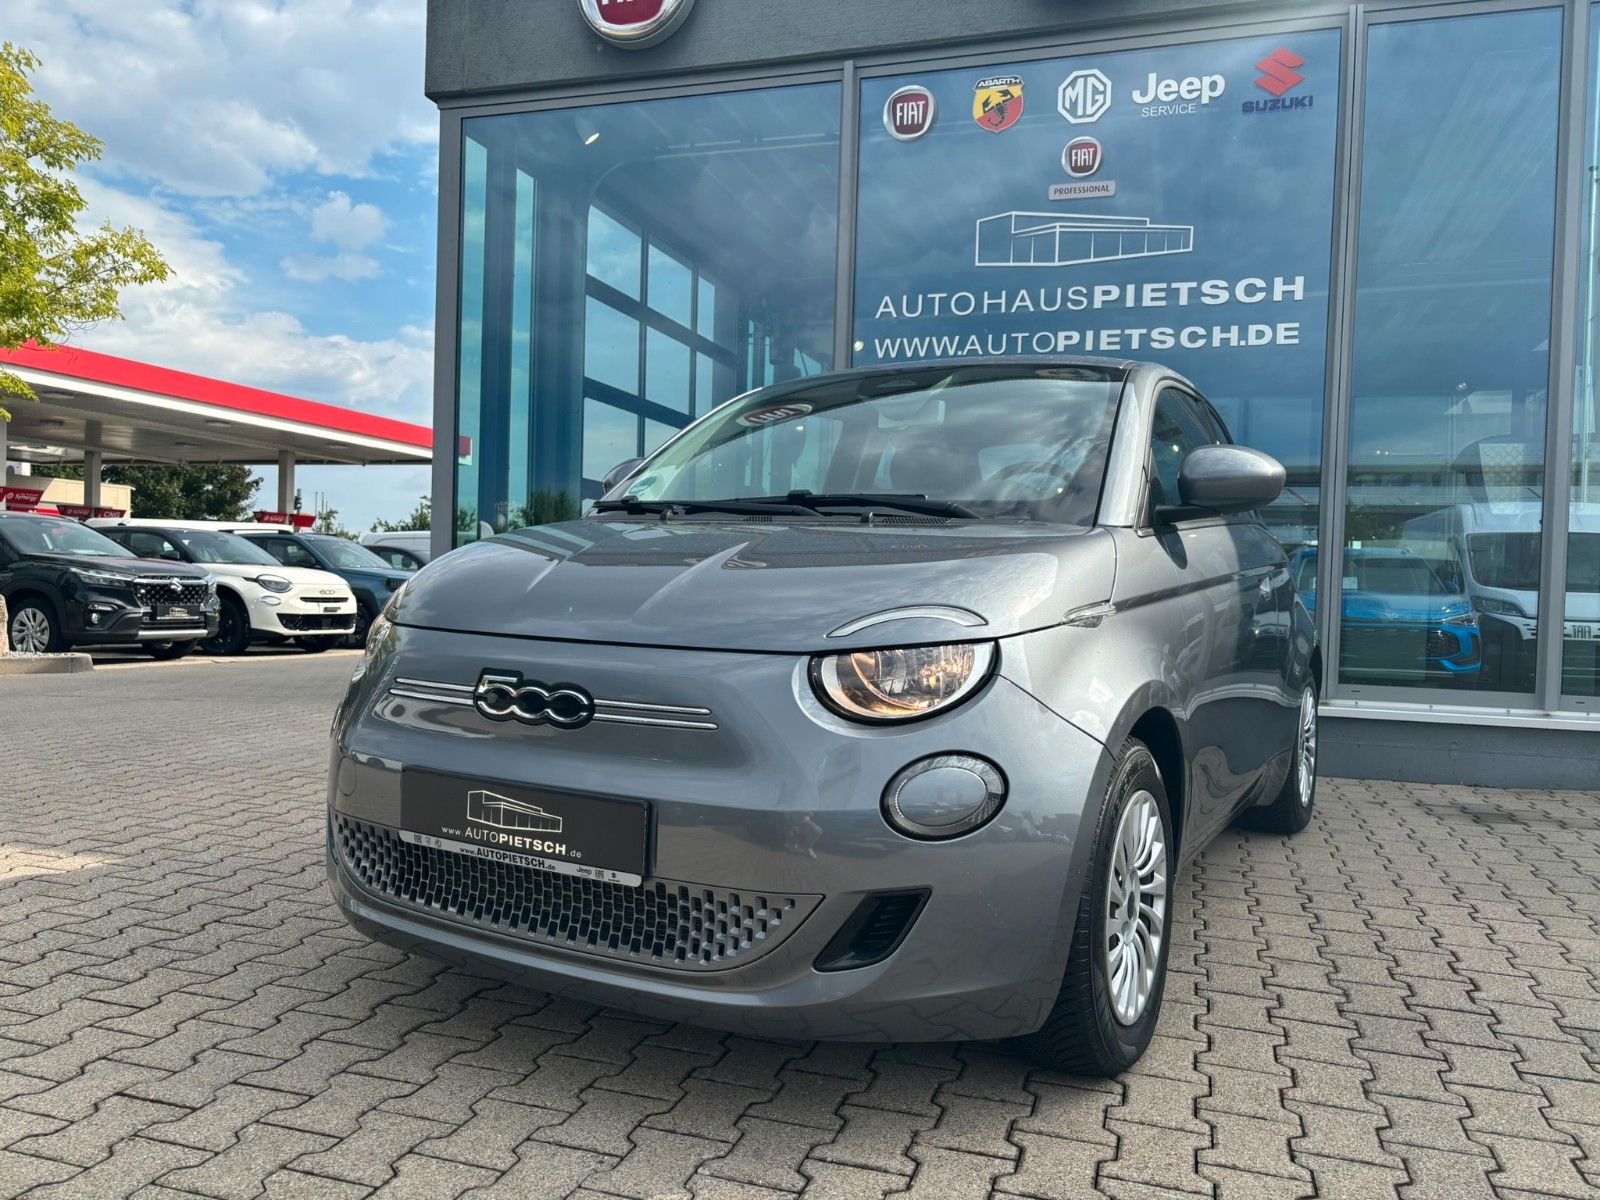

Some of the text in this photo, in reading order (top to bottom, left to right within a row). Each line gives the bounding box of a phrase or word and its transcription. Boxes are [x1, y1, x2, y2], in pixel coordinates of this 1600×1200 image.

[977, 76, 1020, 88] ABARTH
[1131, 72, 1226, 105] Jeep
[1064, 76, 1105, 117] MG
[1141, 103, 1197, 118] SERVICE
[1241, 95, 1314, 114] SUZUKI
[895, 99, 927, 127] FIAT
[1071, 147, 1096, 168] FIAT
[1053, 183, 1111, 196] PROFESSIONAL
[874, 275, 1306, 320] AUTOHAUSPIETSCH
[874, 321, 1301, 360] WWW.AUTOPIETSCH.DE
[474, 668, 594, 728] 500
